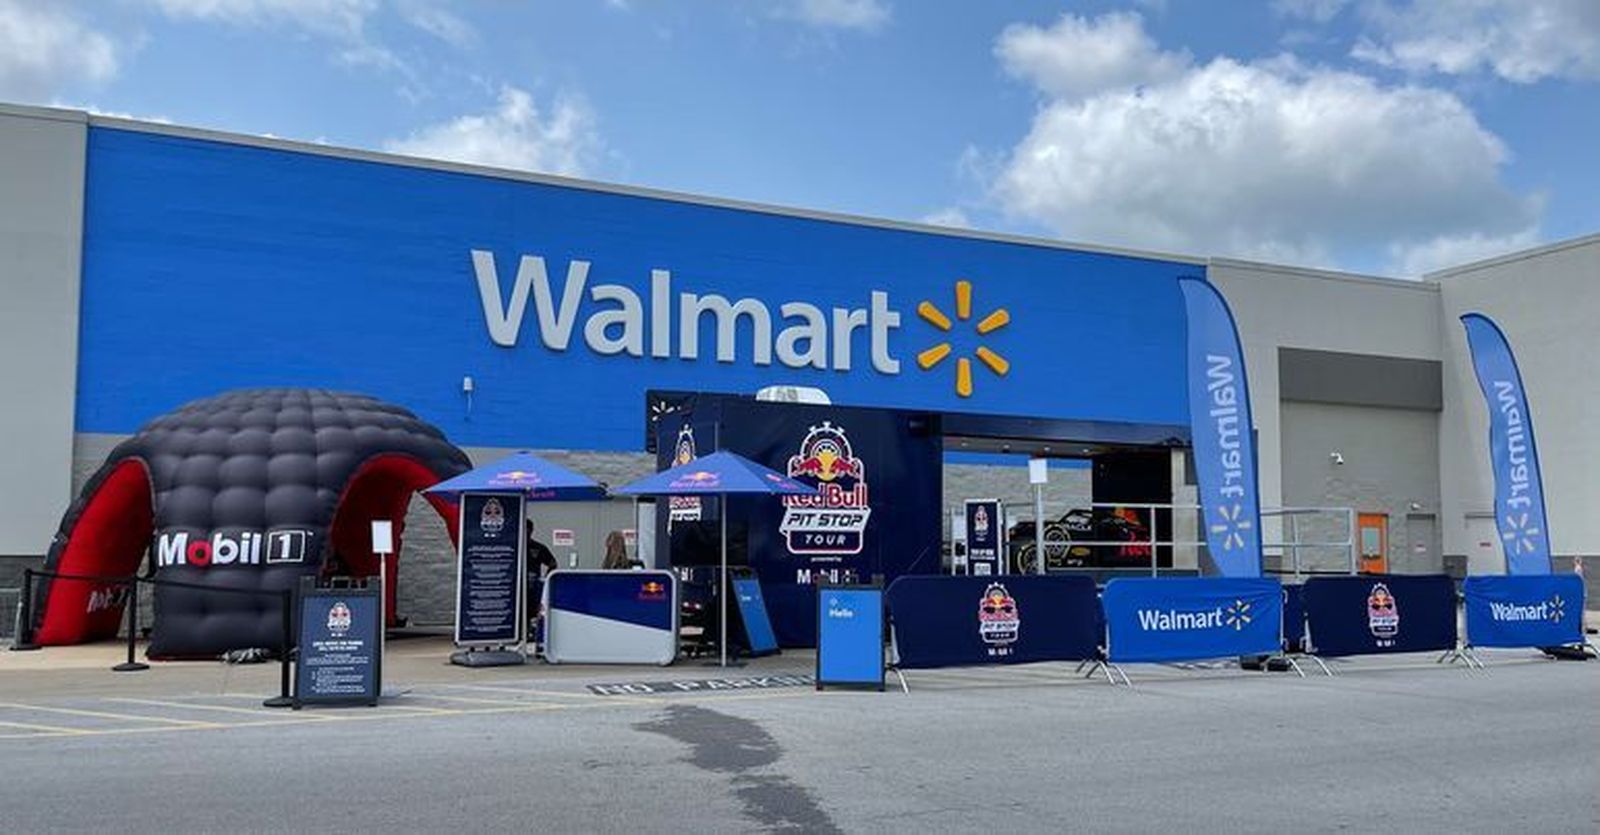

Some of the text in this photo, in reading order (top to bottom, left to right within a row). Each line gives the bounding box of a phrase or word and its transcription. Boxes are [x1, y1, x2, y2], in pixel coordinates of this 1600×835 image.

[471, 249, 899, 373] Walmart
[827, 483, 867, 507] Bull
[788, 513, 863, 526] PIT STOP
[158, 532, 262, 567] Mobil
[805, 534, 846, 545] TOUR
[1138, 606, 1222, 630] Walmart
[1490, 602, 1548, 621] Walmart
[674, 675, 816, 690] PARKIN
